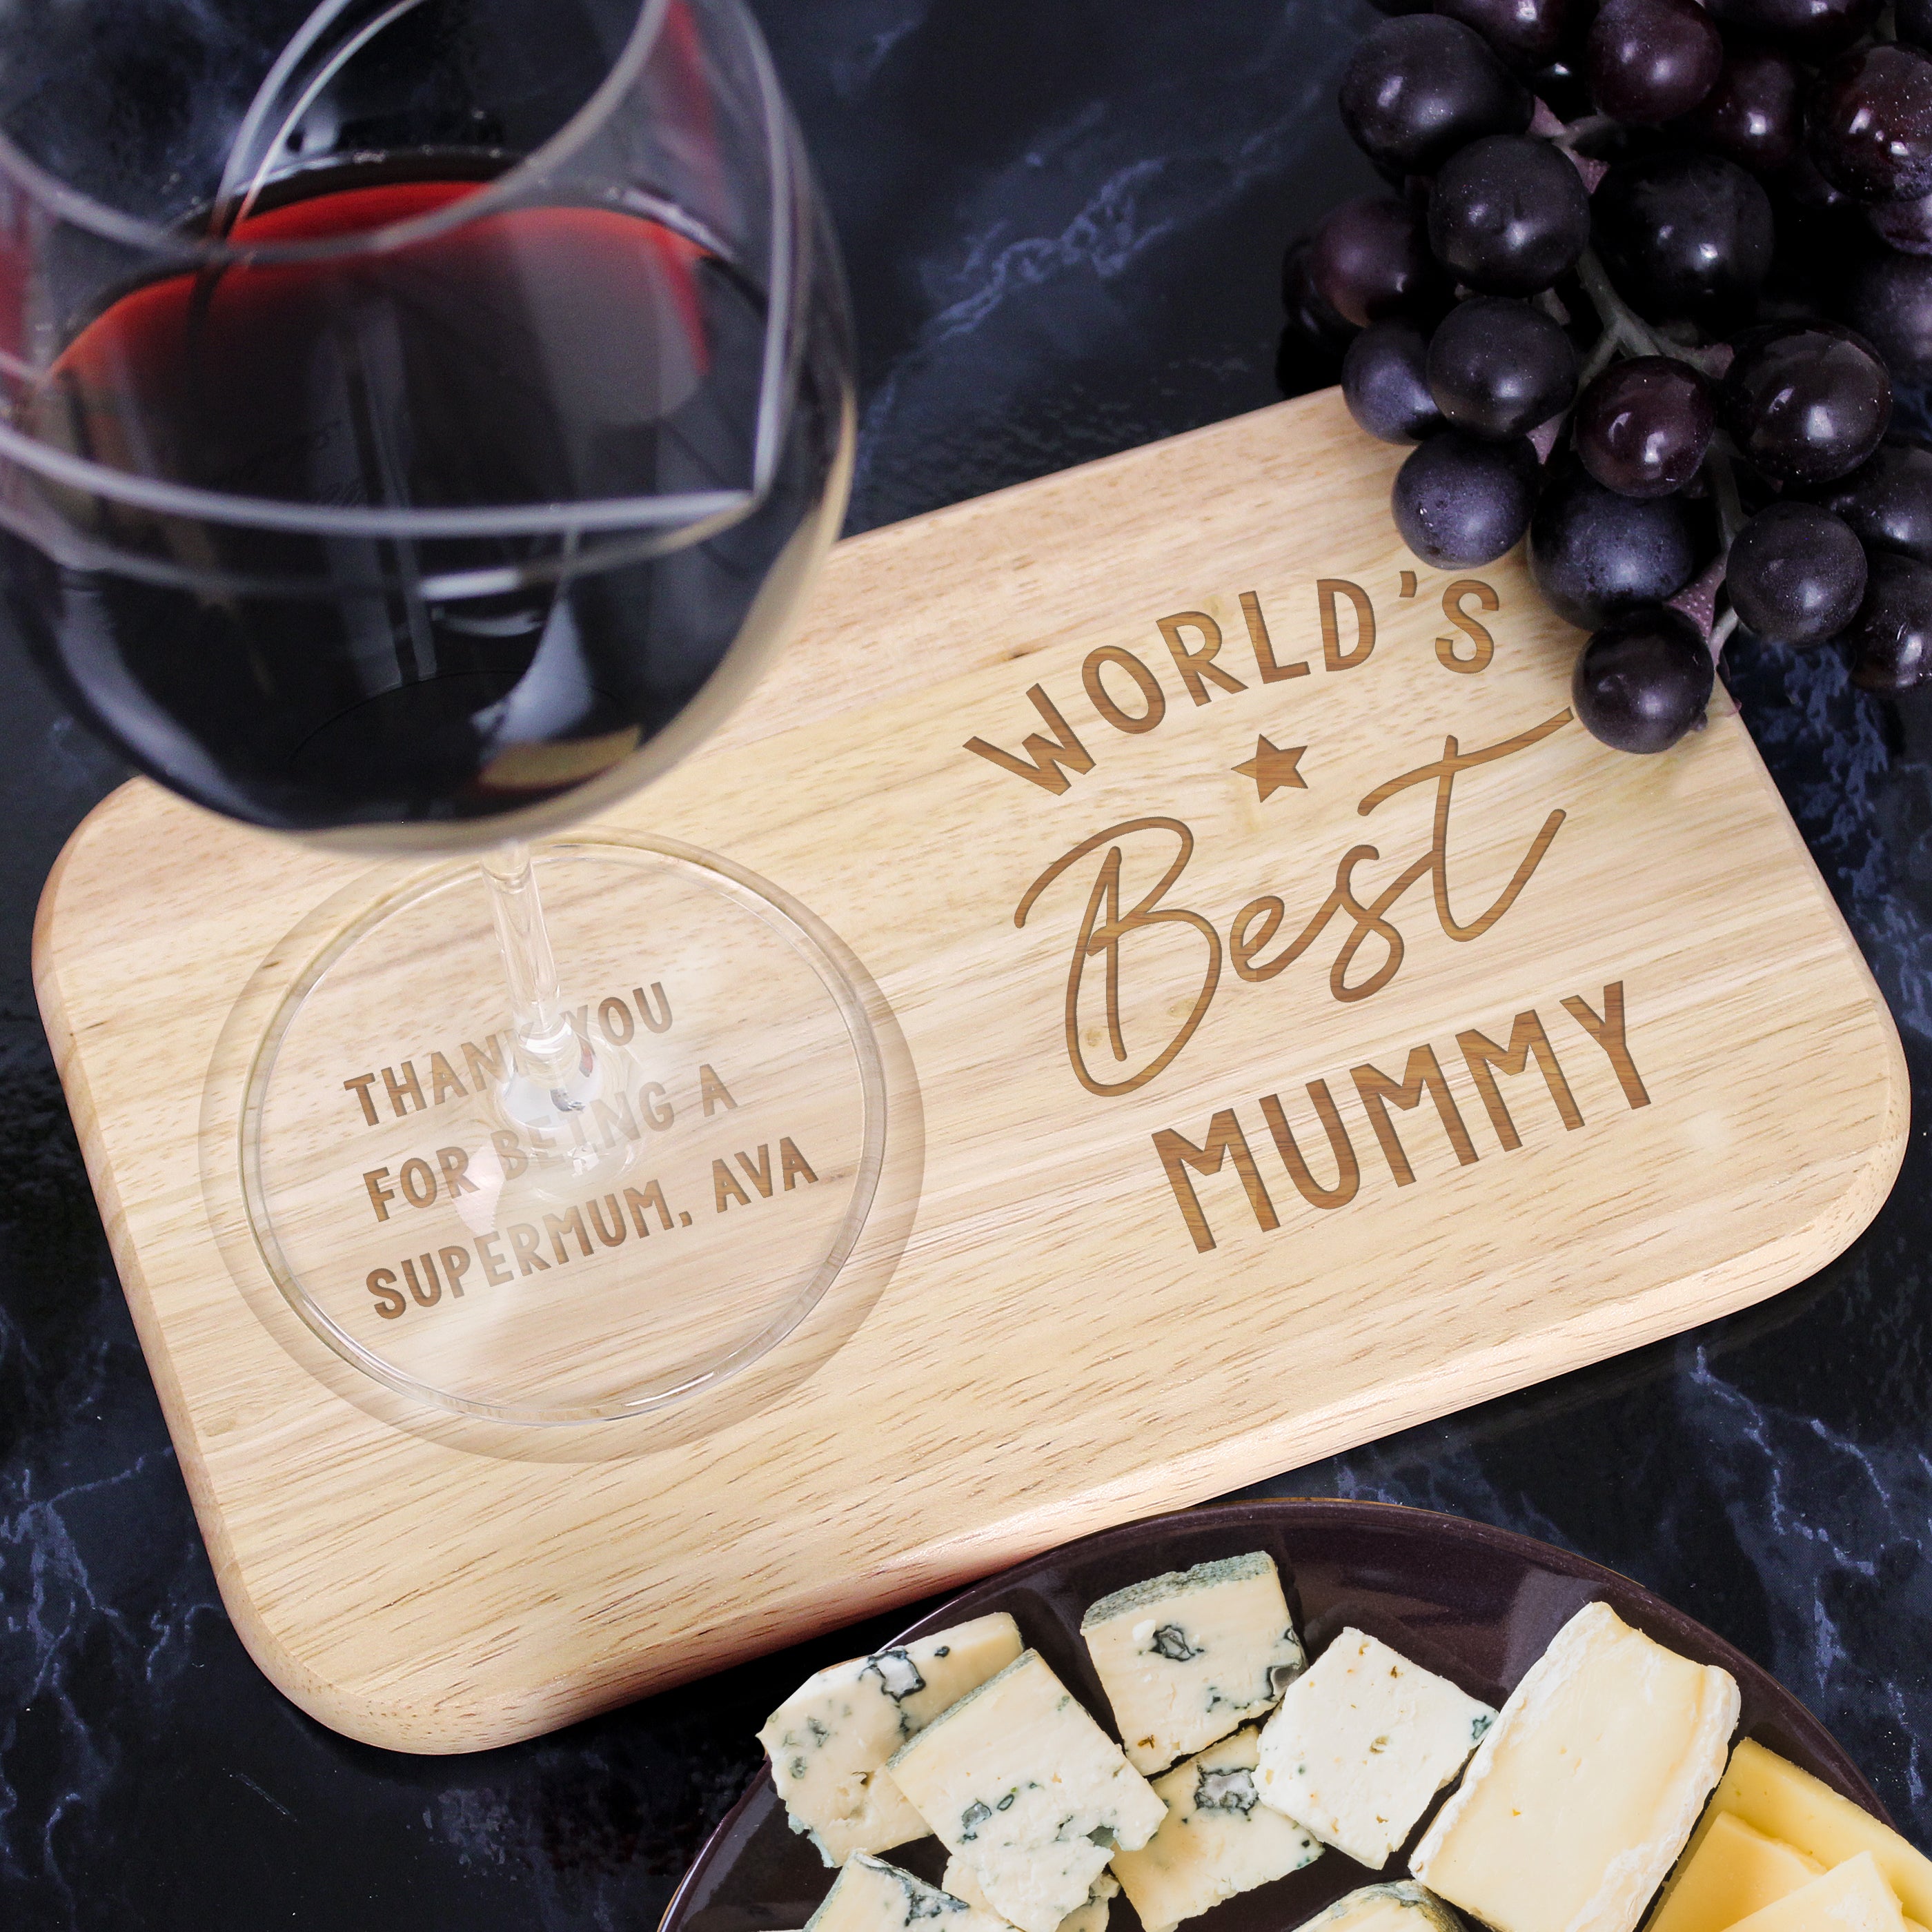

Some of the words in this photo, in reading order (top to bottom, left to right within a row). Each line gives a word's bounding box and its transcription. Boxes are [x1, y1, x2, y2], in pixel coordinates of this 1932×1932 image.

[963, 570, 1501, 796] WORLD'S
[1014, 707, 1574, 1097] Best
[560, 981, 673, 1068] YOU
[1152, 980, 1651, 1254] MUMMY
[363, 1146, 479, 1222] FOR
[491, 1081, 676, 1181] BEING
[699, 1063, 738, 1118] A
[365, 1179, 693, 1320] SUPERMUM,
[713, 1136, 819, 1213] AVA
